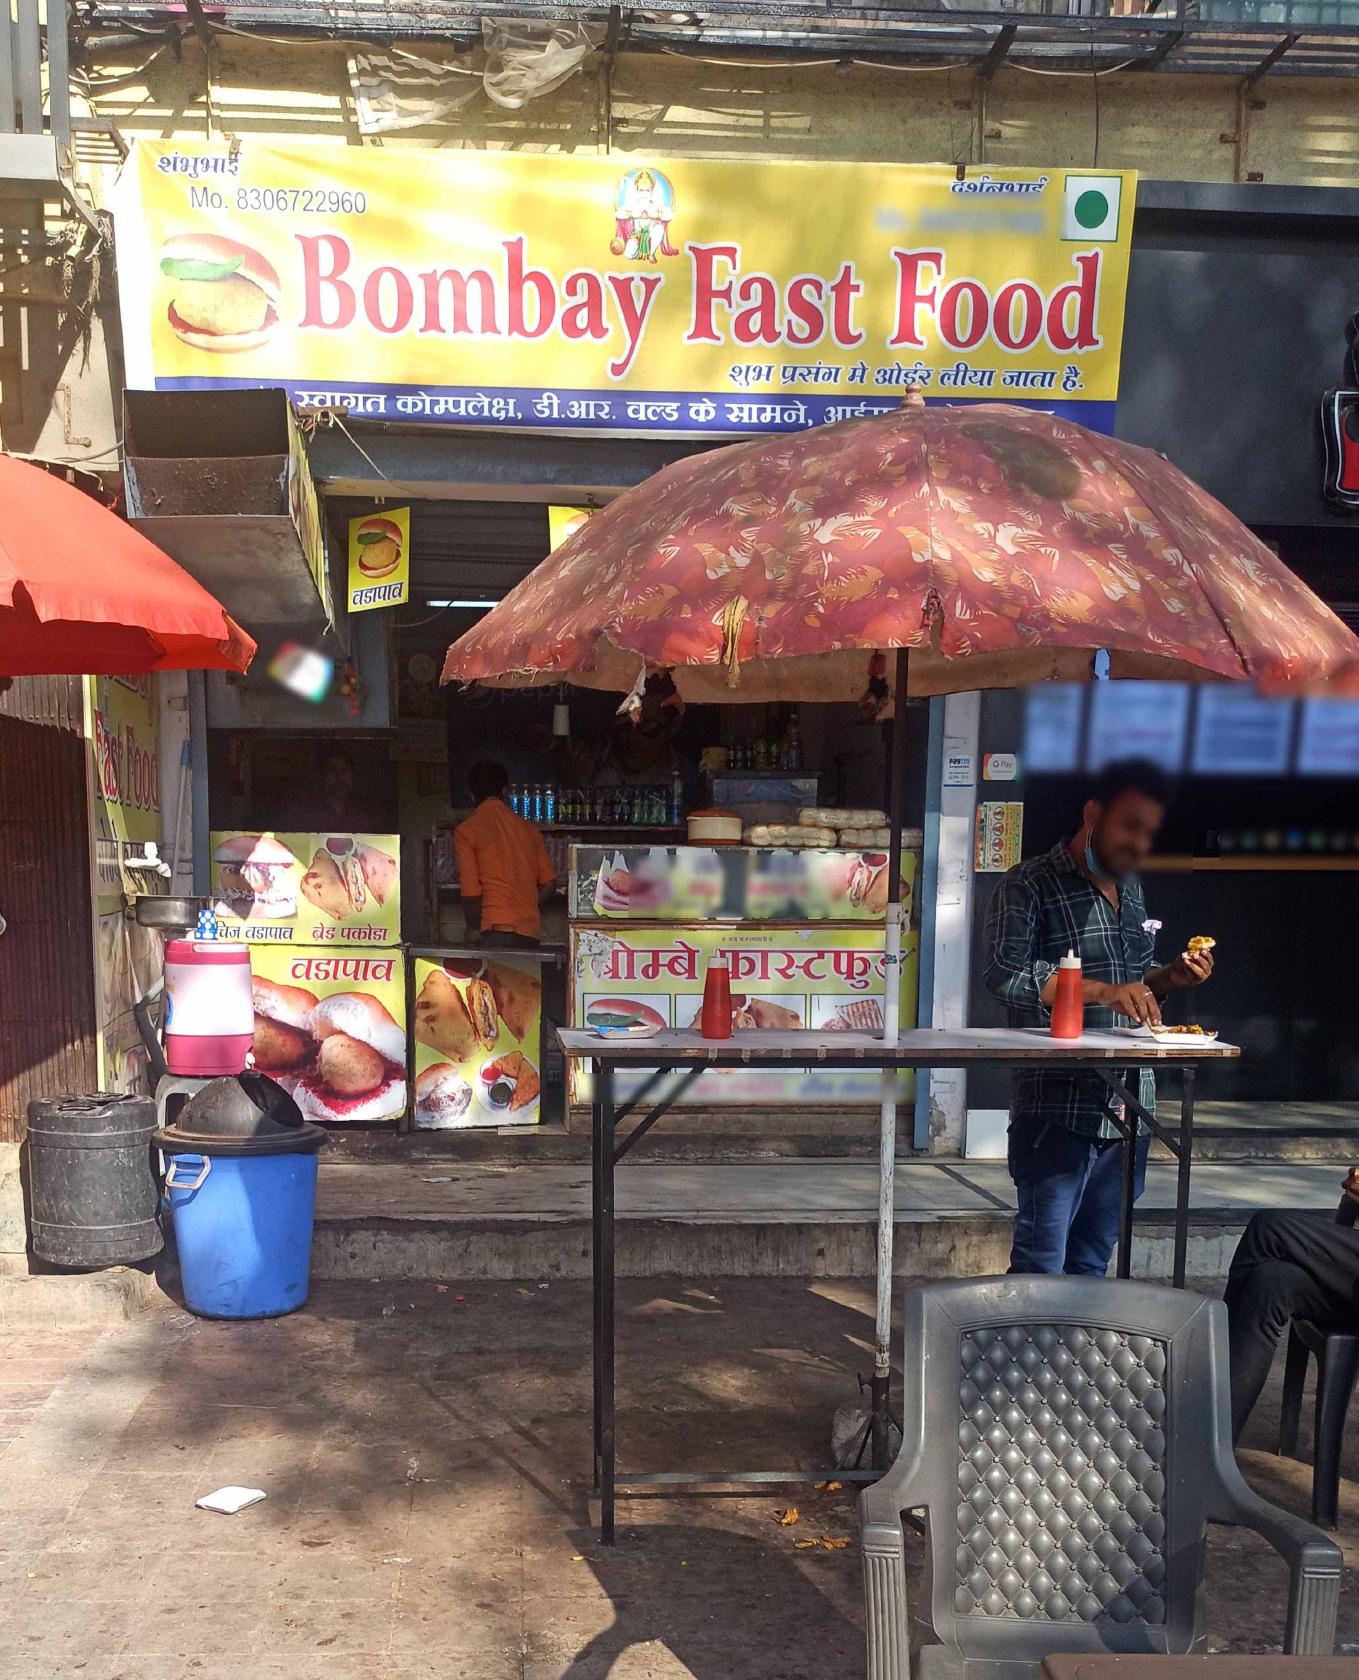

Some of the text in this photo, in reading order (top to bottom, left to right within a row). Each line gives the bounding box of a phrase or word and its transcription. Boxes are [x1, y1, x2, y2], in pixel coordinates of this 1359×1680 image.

[190, 186, 366, 214] Mo. 8306722960
[298, 234, 1101, 383] Bombay Fast Food
[729, 364, 774, 386] शुभ
[781, 361, 842, 385] प्रसंग
[847, 362, 868, 384] मे
[940, 363, 996, 387] लीया
[1002, 370, 1057, 388] जाता
[295, 391, 387, 413] स्वागत
[688, 398, 717, 423] के
[726, 400, 813, 427] सामने,
[352, 582, 404, 606] वडापाव
[245, 926, 294, 941] वडापाव
[340, 924, 388, 941] पकोडा
[291, 958, 396, 981] वडापाव
